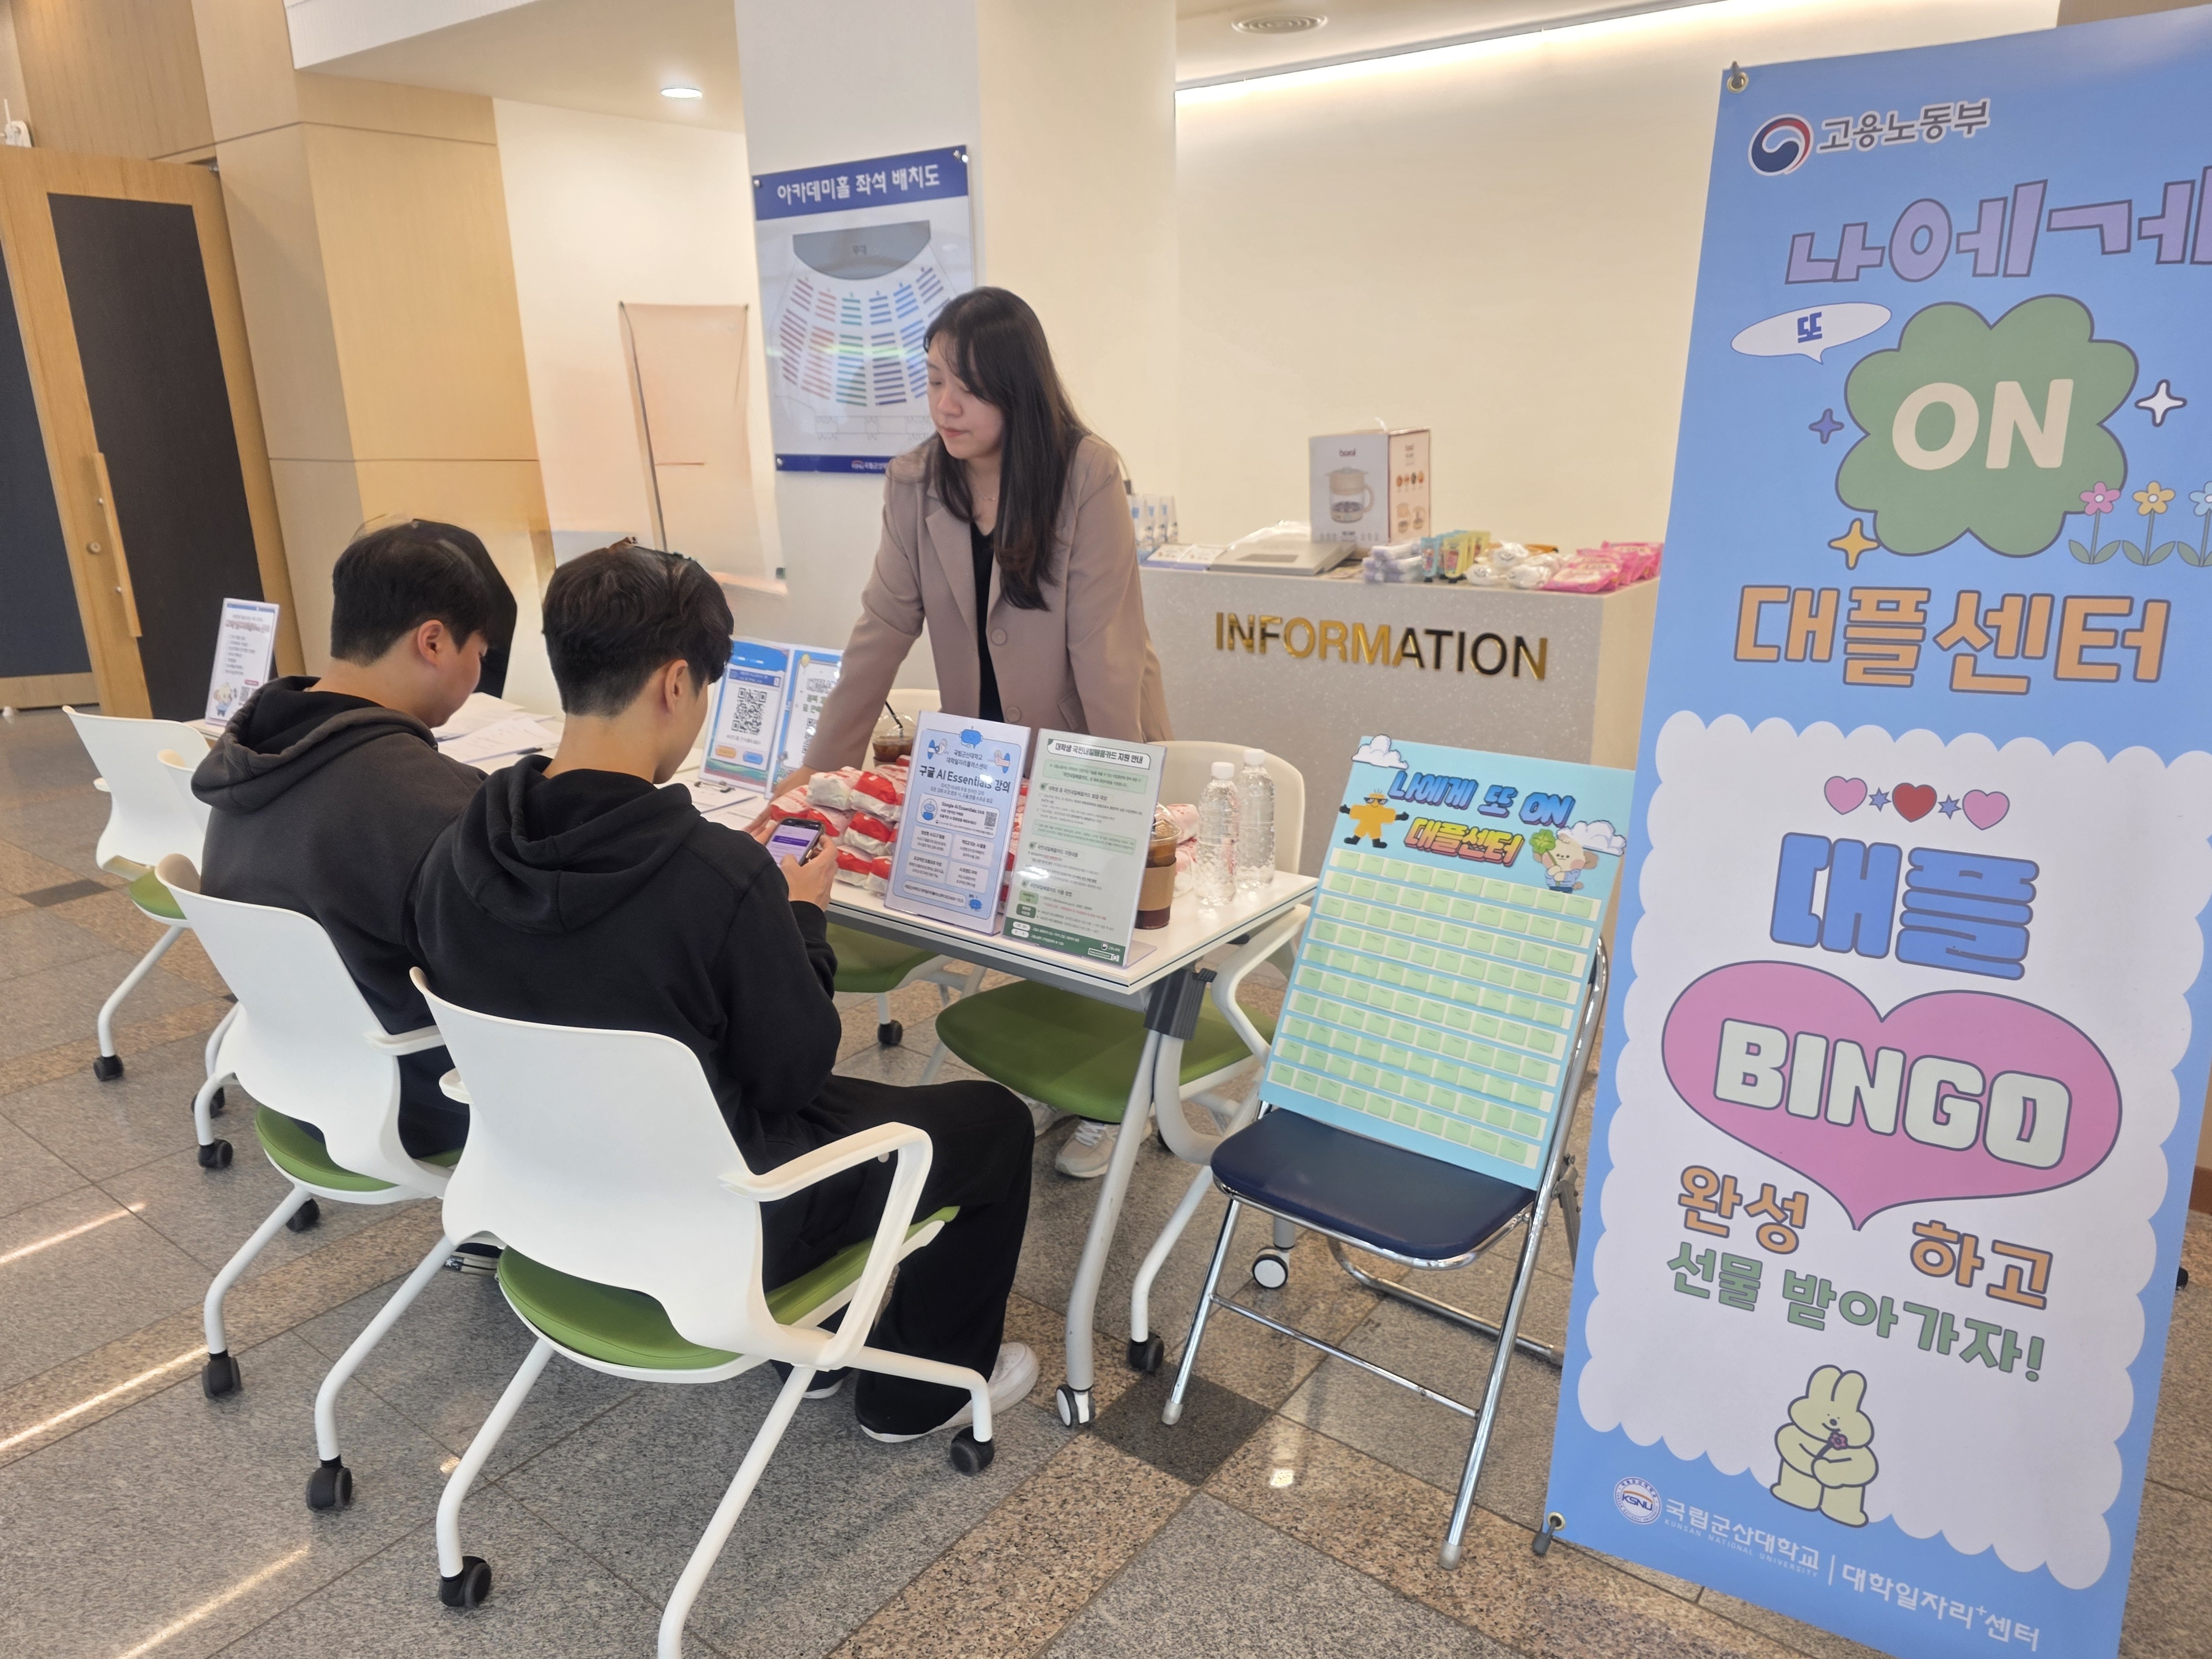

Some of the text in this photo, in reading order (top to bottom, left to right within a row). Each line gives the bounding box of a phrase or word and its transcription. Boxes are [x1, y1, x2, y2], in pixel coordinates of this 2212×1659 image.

[1818, 99, 1991, 152] 고용노동부
[777, 164, 940, 206] 아카데미홀 좌석 배치도
[1785, 165, 2212, 284] 나에게
[1797, 311, 1823, 343] 또
[1892, 379, 2074, 471] ON
[1215, 611, 1549, 680] INFORMATION
[1734, 585, 2171, 695] 대플센터
[919, 765, 935, 778] 구글
[936, 769, 946, 780] AI
[993, 779, 1011, 793] 강의
[953, 749, 983, 760] 국립군산대학교
[1055, 743, 1072, 753] 대학생
[1118, 753, 1130, 761] 지원
[1130, 755, 1143, 764] 안내
[1387, 770, 1575, 828] 나에게 또 ON
[1404, 816, 1525, 867] 대플센터
[1770, 832, 2039, 980] 대플
[1713, 1018, 2072, 1169] BINGO
[1678, 1165, 2053, 1310] 완성 하고
[1667, 1241, 2046, 1382] 선물 받아가자!
[1623, 1494, 1653, 1511] KSNU
[1665, 1519, 1818, 1578] KUNSAN NATIONAL UNIVERSITY
[1666, 1499, 1819, 1570] 국립군산대학교
